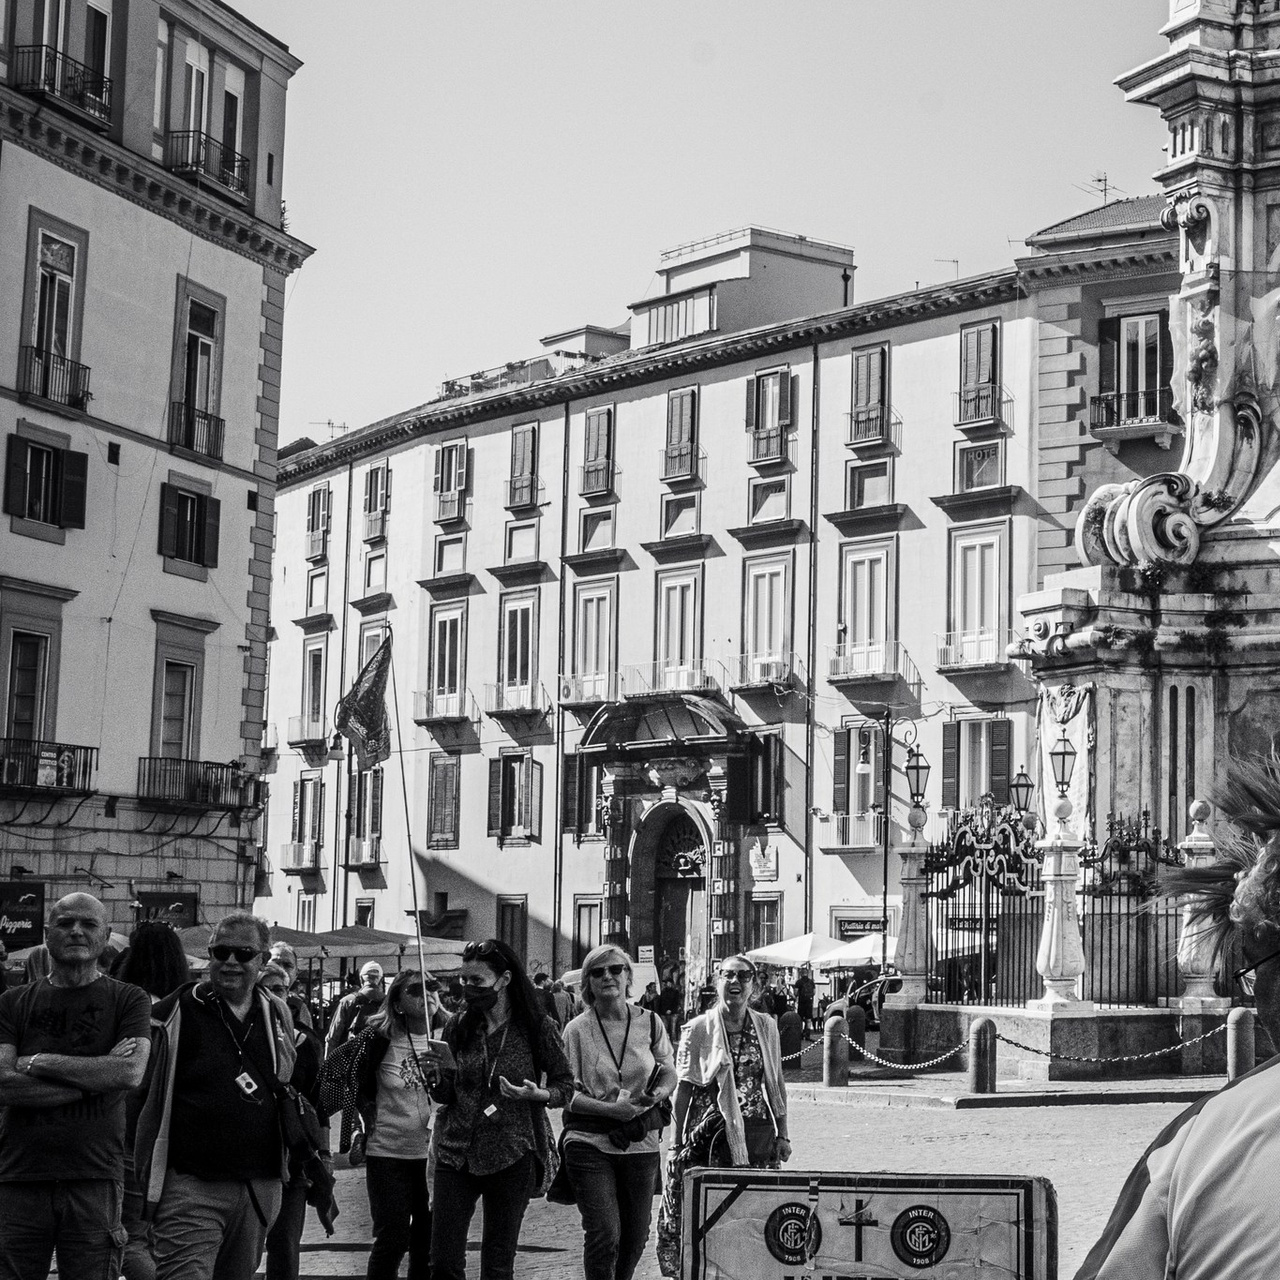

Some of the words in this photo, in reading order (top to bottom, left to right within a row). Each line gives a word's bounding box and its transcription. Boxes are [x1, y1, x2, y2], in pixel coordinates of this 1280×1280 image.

[782, 1206, 806, 1217] INTER
[908, 1209, 934, 1219] INTER
[784, 1254, 802, 1262] 1908
